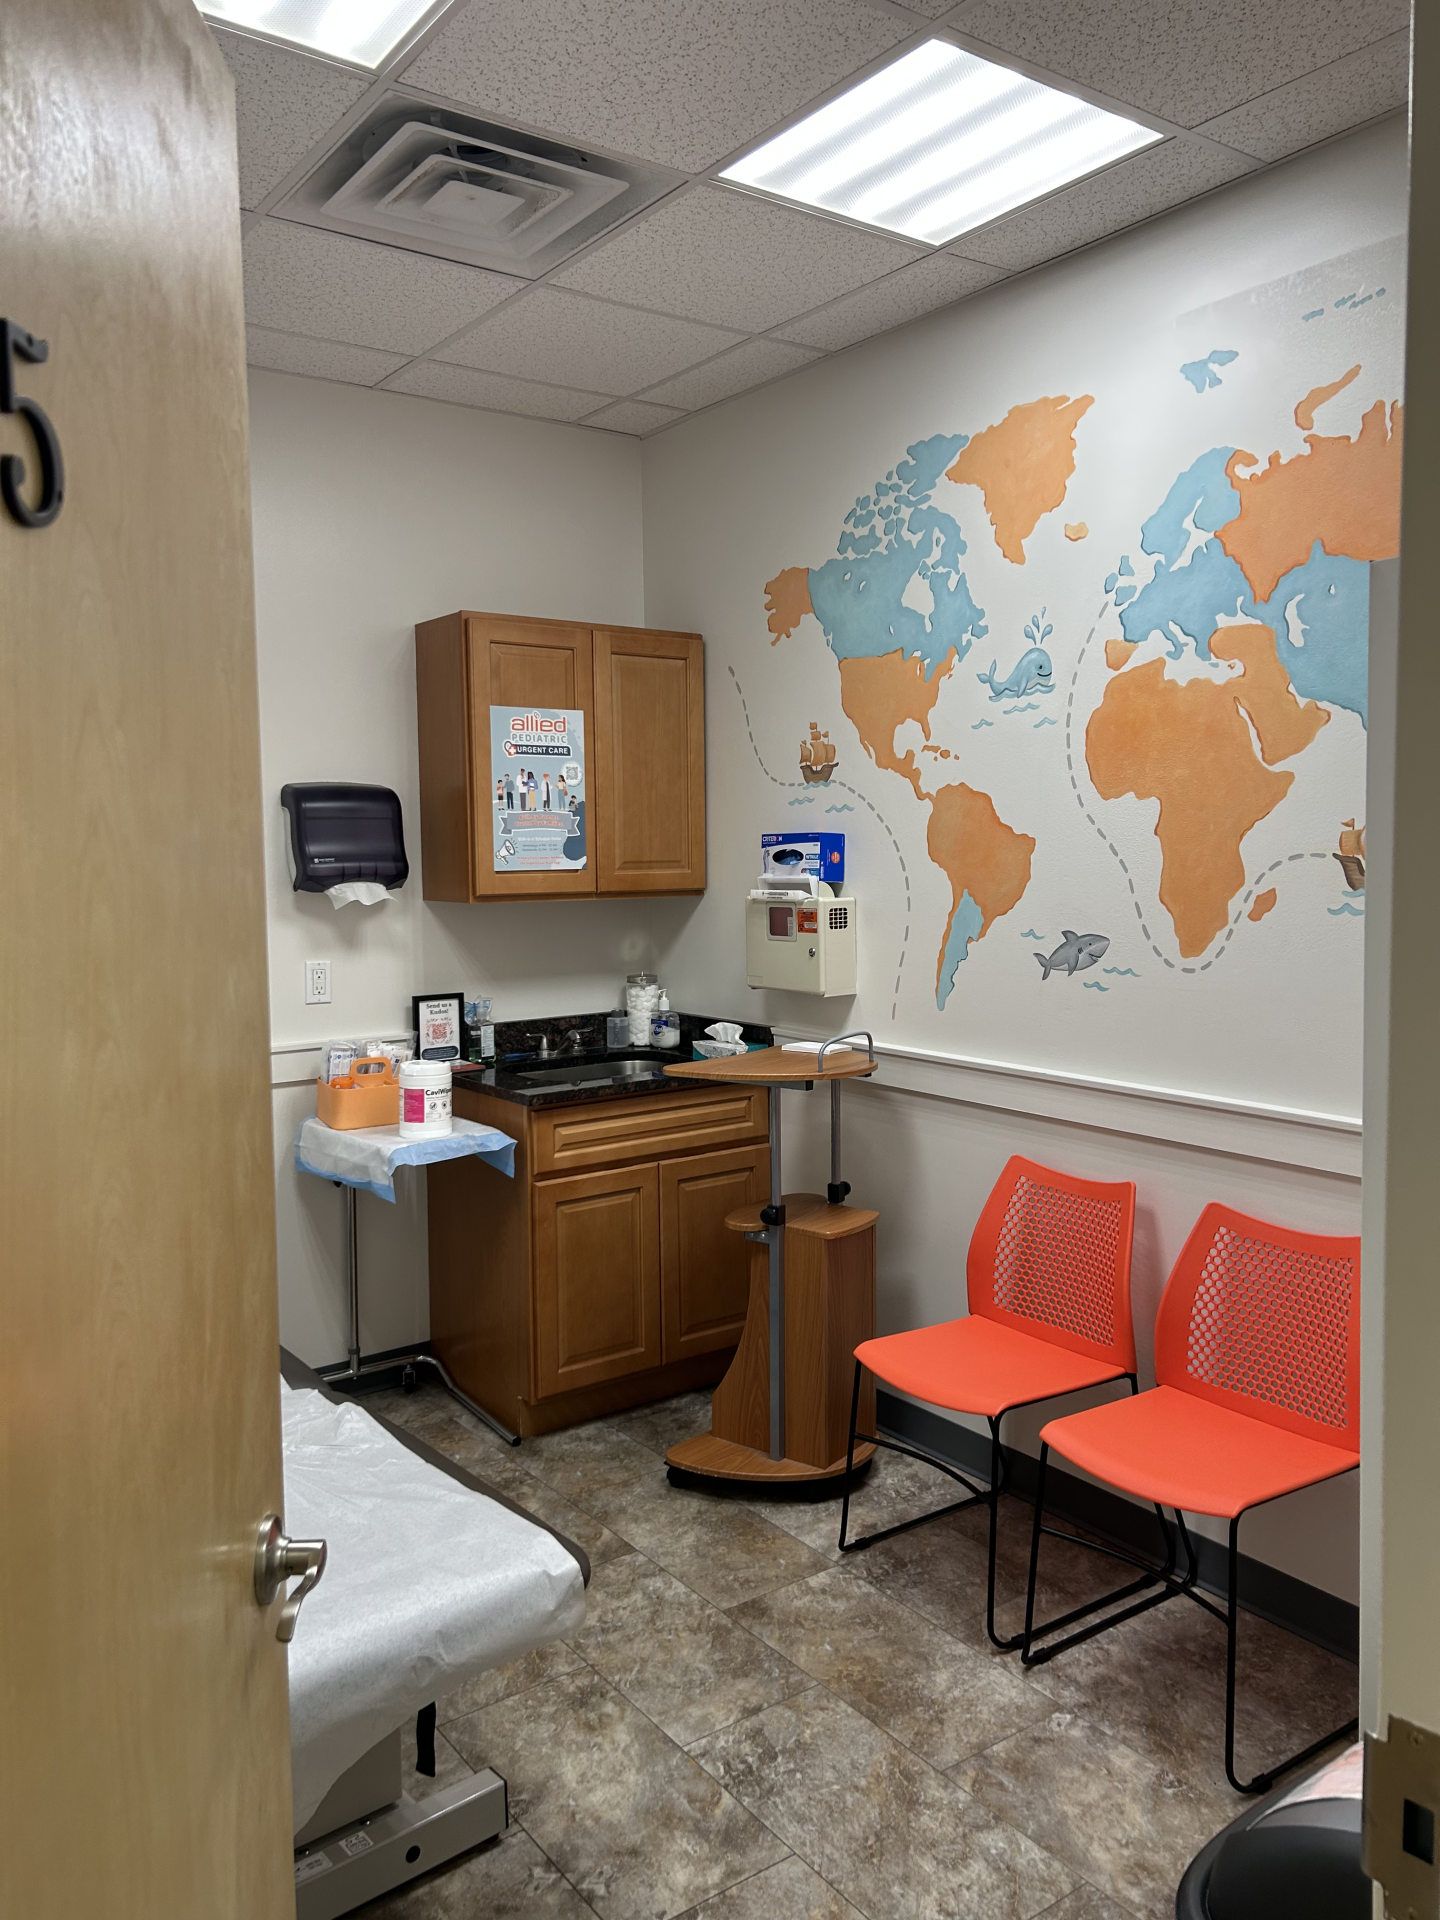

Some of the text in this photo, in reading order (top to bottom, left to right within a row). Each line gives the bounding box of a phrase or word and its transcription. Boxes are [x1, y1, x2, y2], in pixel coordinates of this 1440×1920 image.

[0, 317, 65, 528] 5
[512, 715, 566, 733] allied
[512, 734, 567, 744] PEDIATRIC
